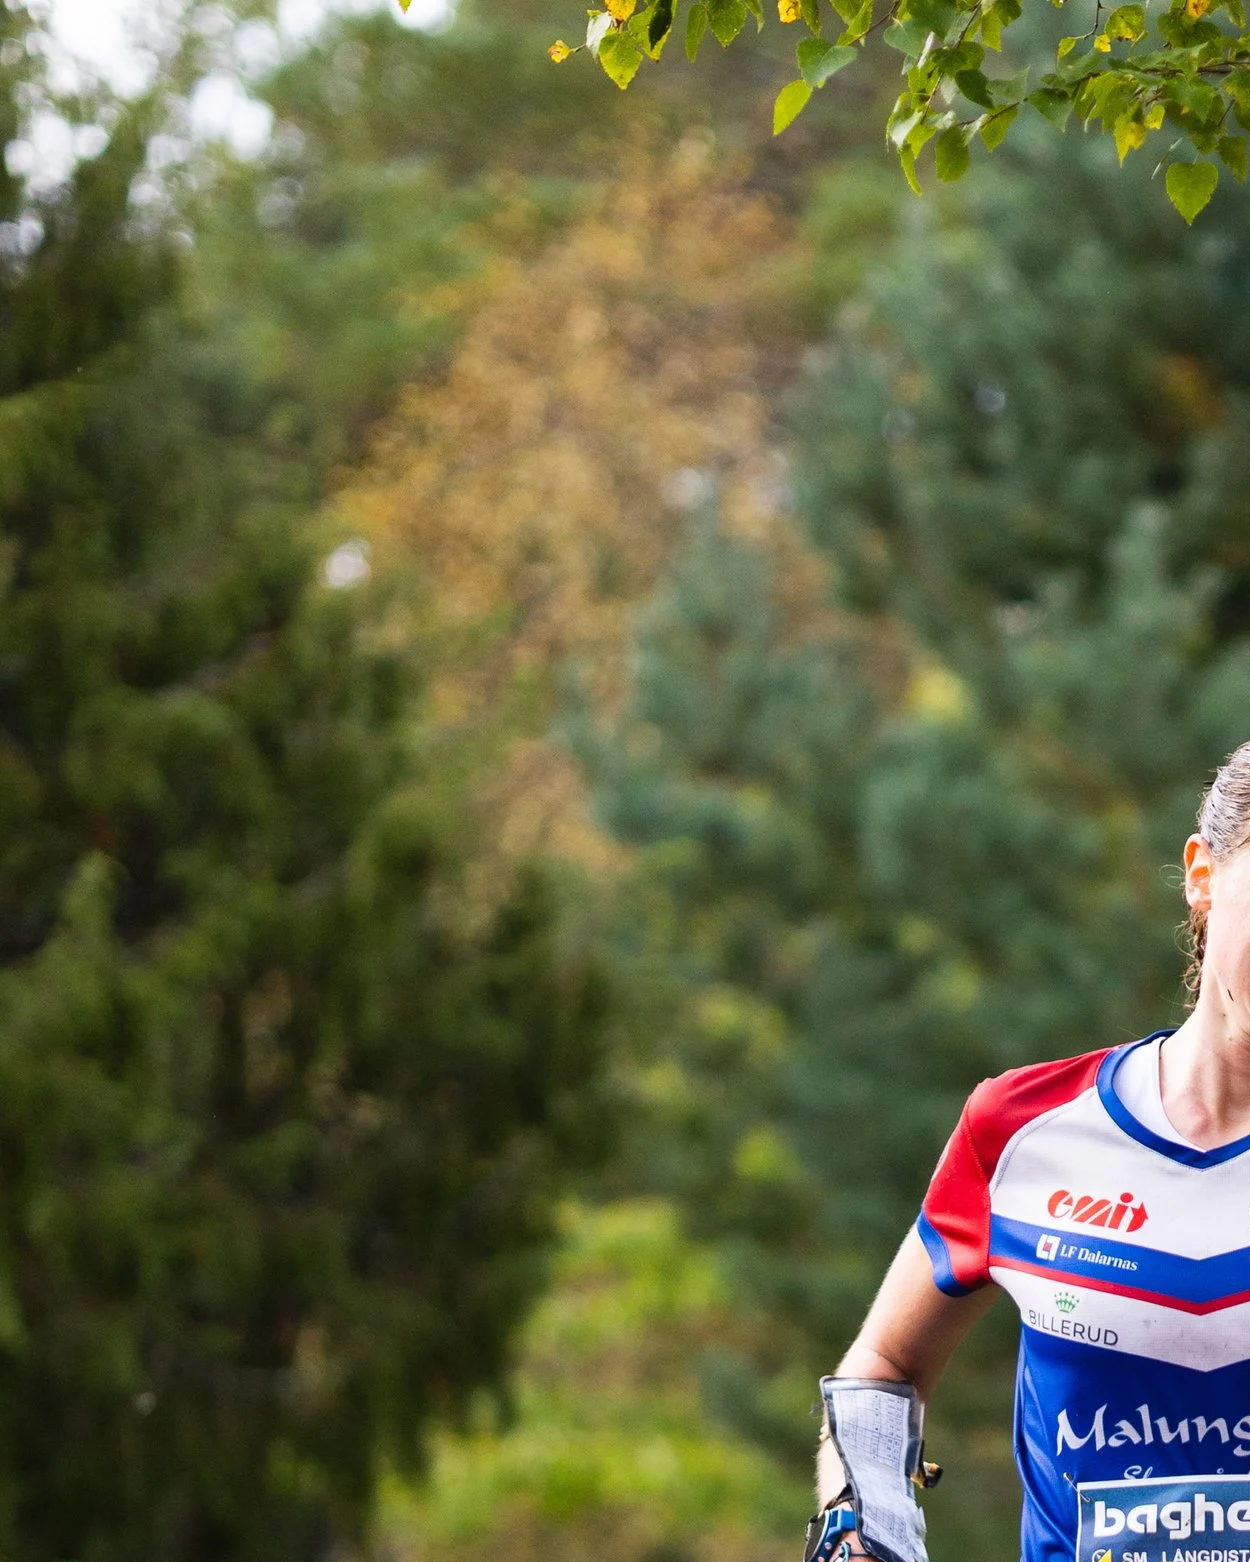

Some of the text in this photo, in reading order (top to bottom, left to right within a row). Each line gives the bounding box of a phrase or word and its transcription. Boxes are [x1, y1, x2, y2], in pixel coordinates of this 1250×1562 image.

[1047, 1189, 1149, 1232] emit
[1060, 1243, 1138, 1271] LF Dalarnas
[1028, 1309, 1119, 1346] BILLERUD
